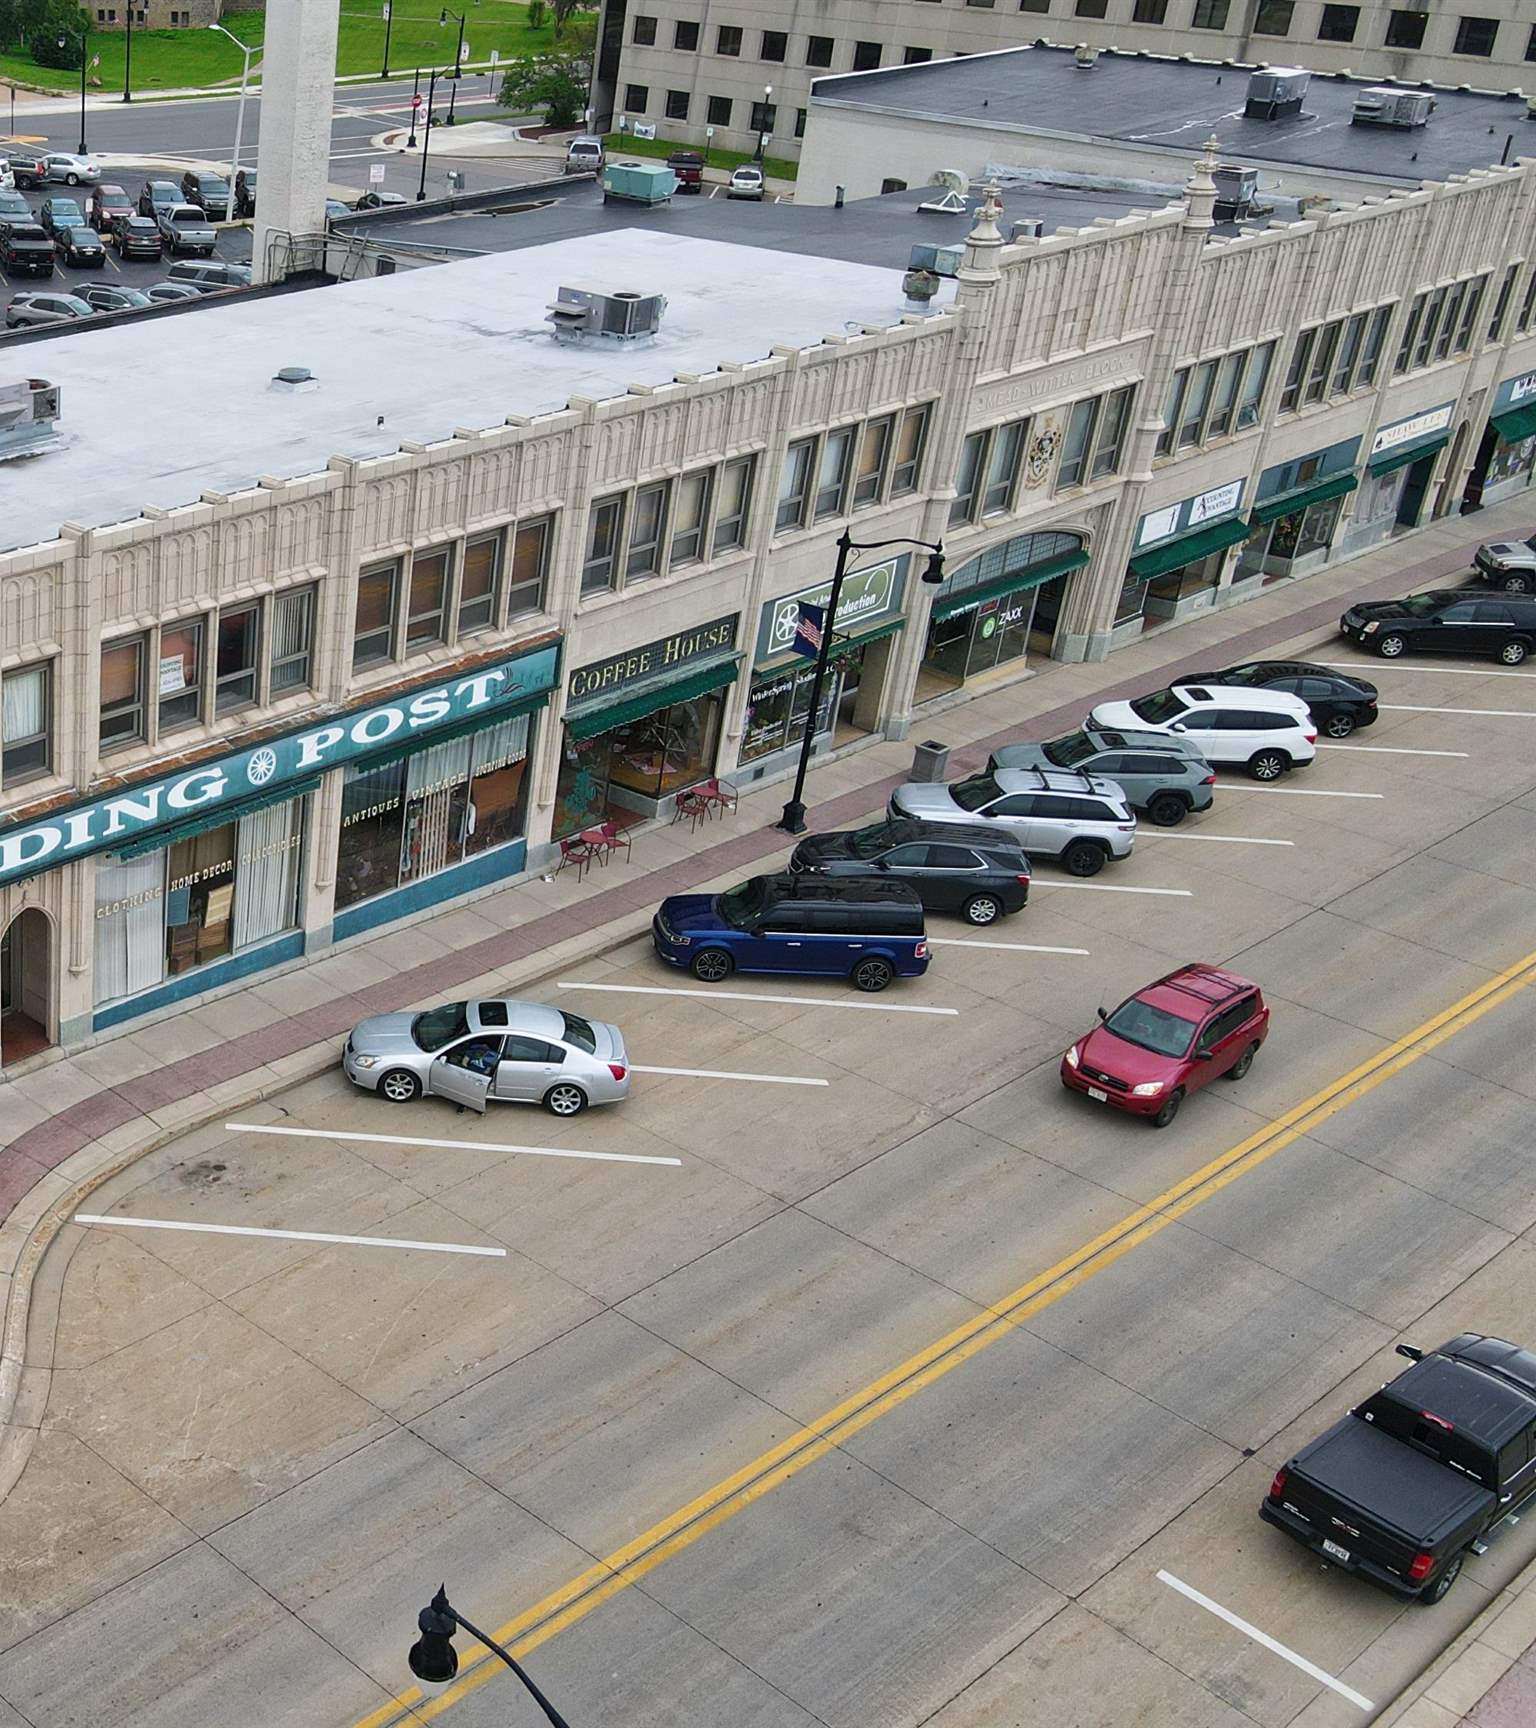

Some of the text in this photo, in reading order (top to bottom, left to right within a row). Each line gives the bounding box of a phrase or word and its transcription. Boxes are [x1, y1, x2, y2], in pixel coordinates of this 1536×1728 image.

[998, 605, 1023, 625] ZAXX
[570, 623, 730, 697] COFFEE HOUSE
[296, 670, 505, 769] POST
[343, 796, 401, 828] ANTIQUES
[411, 771, 465, 801] VINTAGE
[96, 887, 162, 920] CLOTHING
[170, 872, 200, 892] HOME
[202, 859, 234, 881] DECOR
